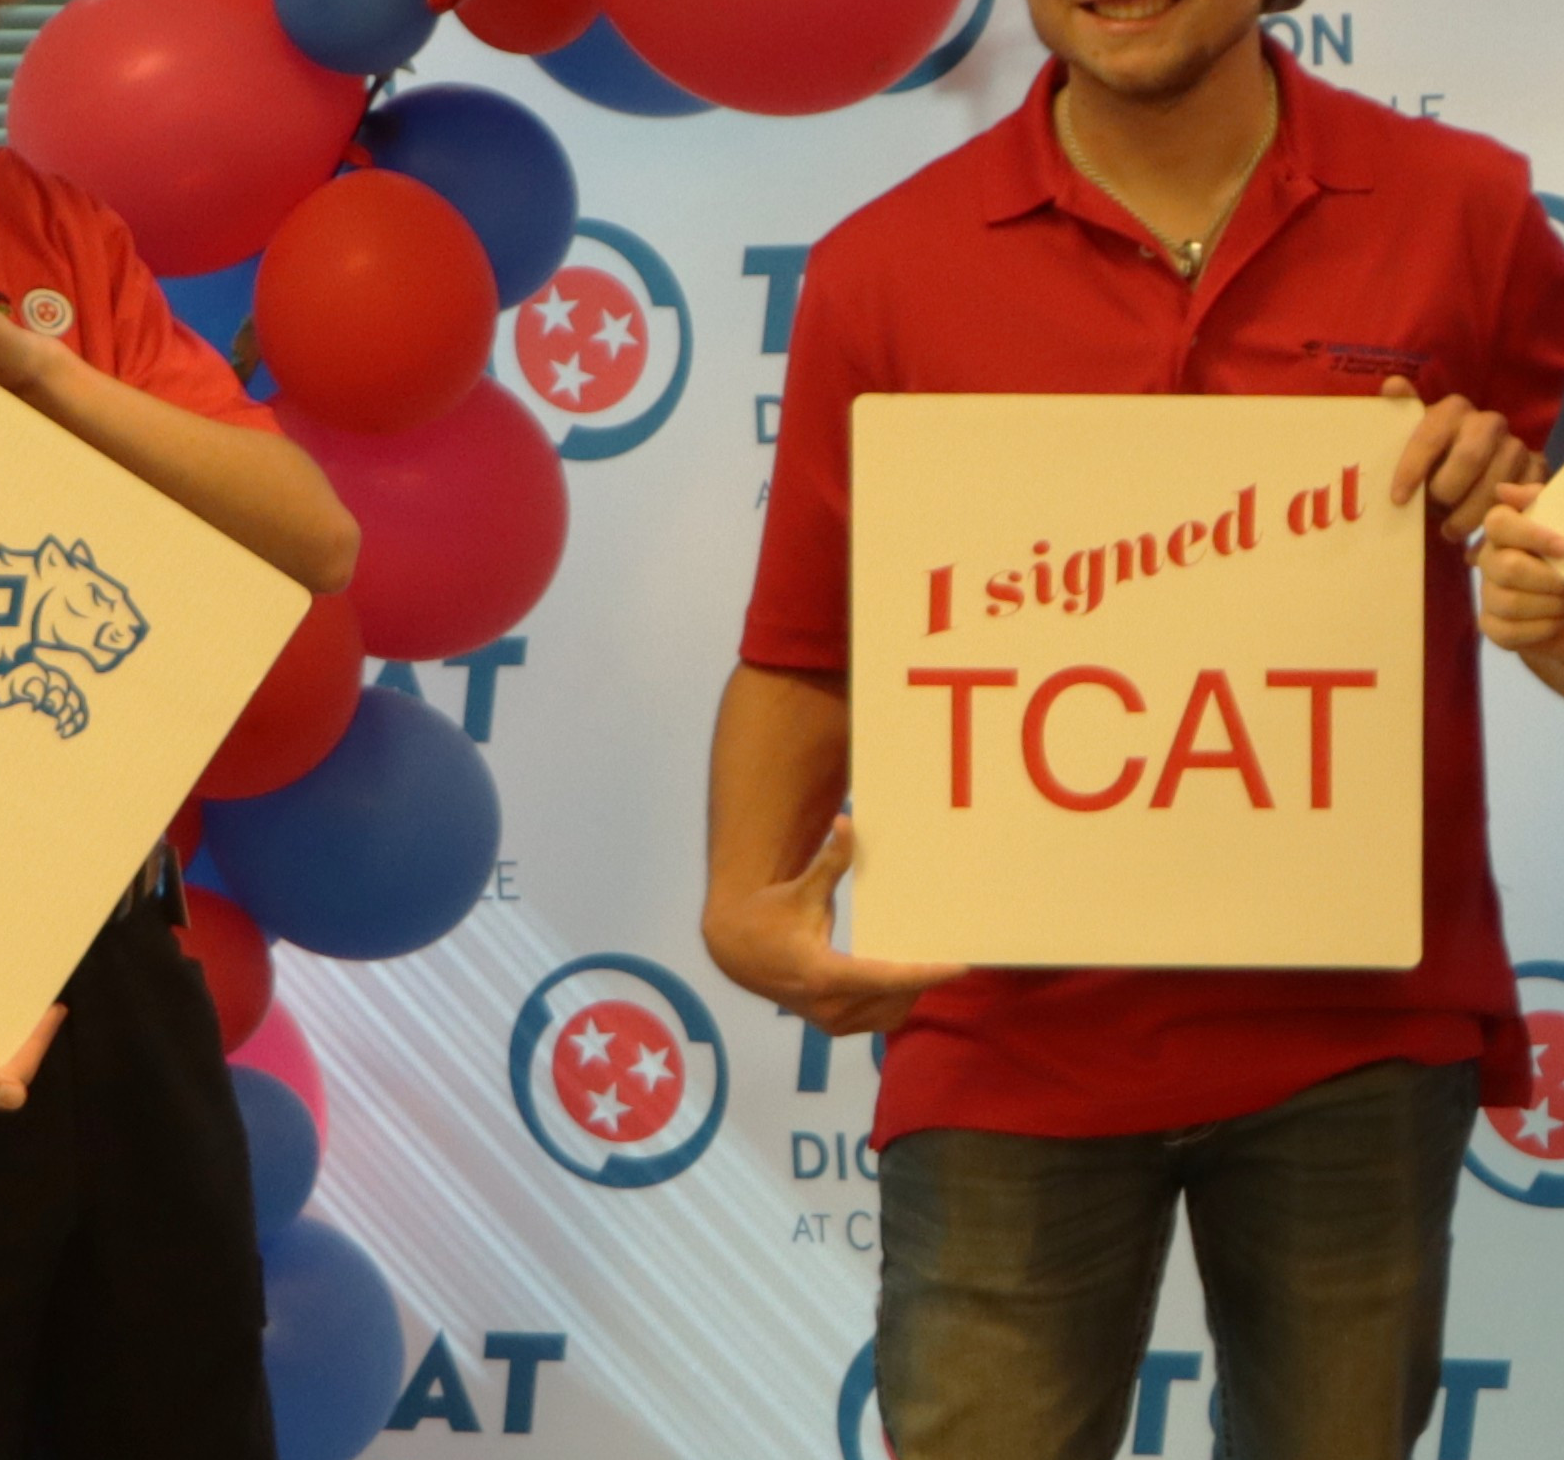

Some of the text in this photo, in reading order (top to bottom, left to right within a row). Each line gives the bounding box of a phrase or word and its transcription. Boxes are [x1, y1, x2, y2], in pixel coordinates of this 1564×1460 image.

[922, 462, 1368, 638] I signed at
[906, 664, 1379, 813] TCAT
[791, 1212, 832, 1244] AT
[383, 1328, 568, 1435] AT
